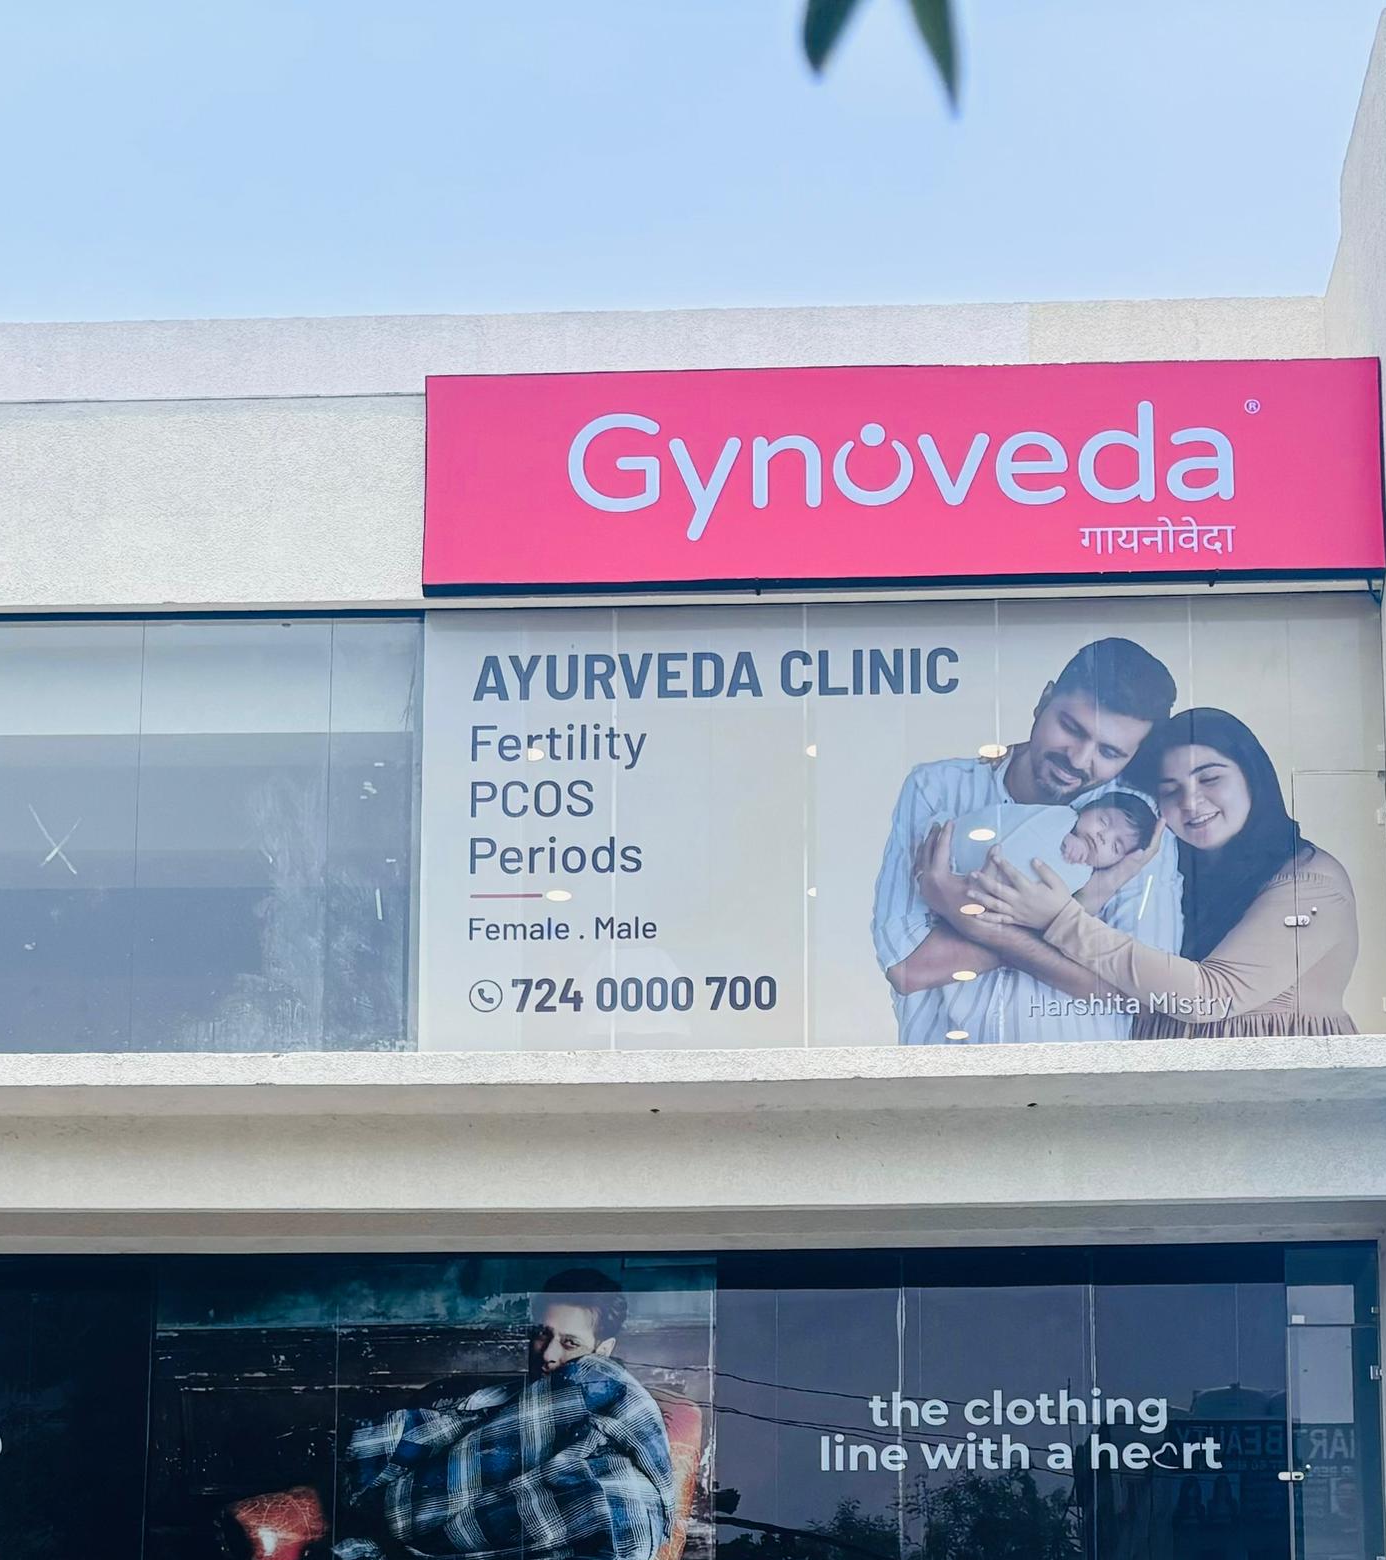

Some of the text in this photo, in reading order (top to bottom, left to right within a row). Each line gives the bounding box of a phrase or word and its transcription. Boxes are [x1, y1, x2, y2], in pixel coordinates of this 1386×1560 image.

[567, 400, 1235, 541] Gynoveda
[1079, 516, 1236, 554] गायनोवेदा
[473, 647, 960, 702] AYURVEDA CLINIC
[470, 724, 647, 770] Fertility
[470, 780, 595, 819] PCOS
[469, 836, 643, 875] Periods
[468, 917, 570, 941] Female
[593, 916, 658, 941] Male
[511, 975, 778, 1013] 724 0000 700
[1028, 991, 1234, 1020] Harshita Mistry
[868, 1387, 1168, 1435] the clothing
[820, 1433, 909, 1472] line
[921, 1432, 1030, 1470] with
[1046, 1442, 1074, 1470] a
